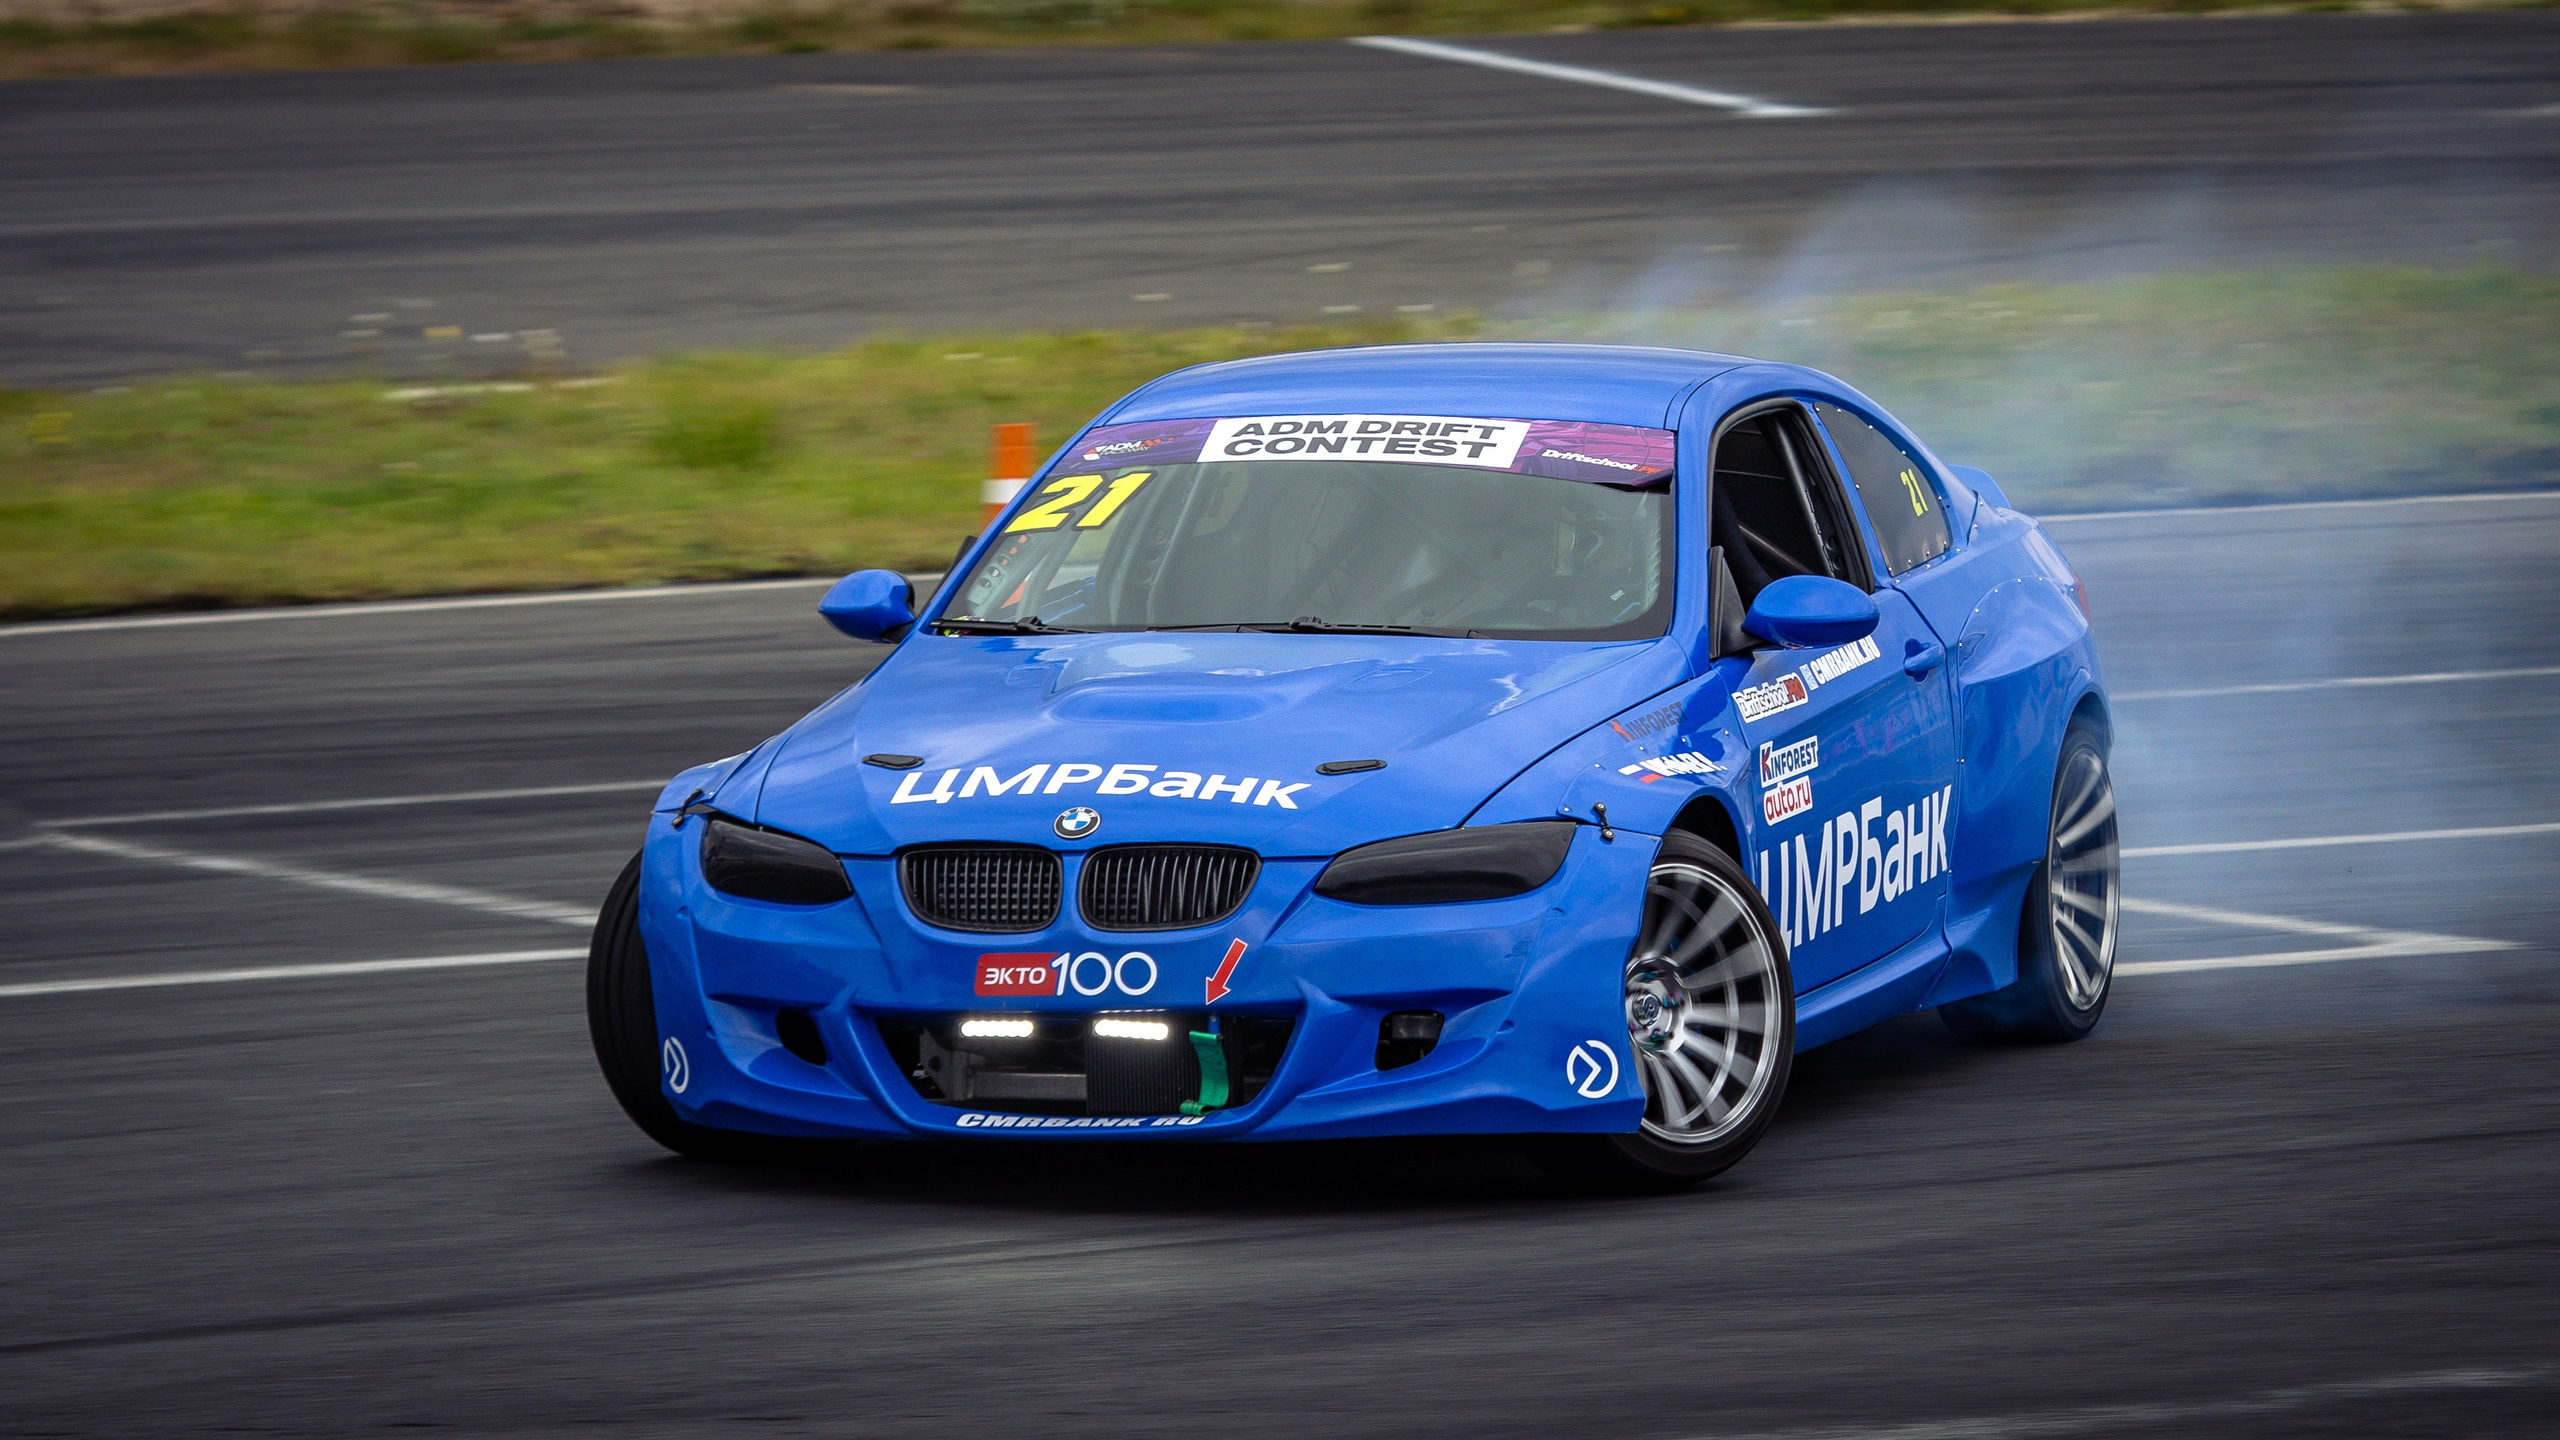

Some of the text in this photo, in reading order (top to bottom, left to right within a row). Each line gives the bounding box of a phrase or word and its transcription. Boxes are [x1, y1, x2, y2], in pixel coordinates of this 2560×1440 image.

[1102, 440, 1142, 452] ADM
[1223, 437, 1497, 459] CONTEST
[1231, 420, 1505, 440] ADM DRIFT
[1002, 471, 1154, 535] 21
[1900, 468, 1929, 517] 21
[1810, 634, 1881, 685] CMRBANK.RU
[1607, 701, 1687, 743] KINFOREST
[1761, 740, 1818, 783] KINFOREST
[890, 763, 1312, 809] ЦМРБанк
[1765, 780, 1811, 821] auto.ru
[1760, 784, 1952, 961] ЦМРБанк
[983, 951, 1158, 996] ЭКТО 100
